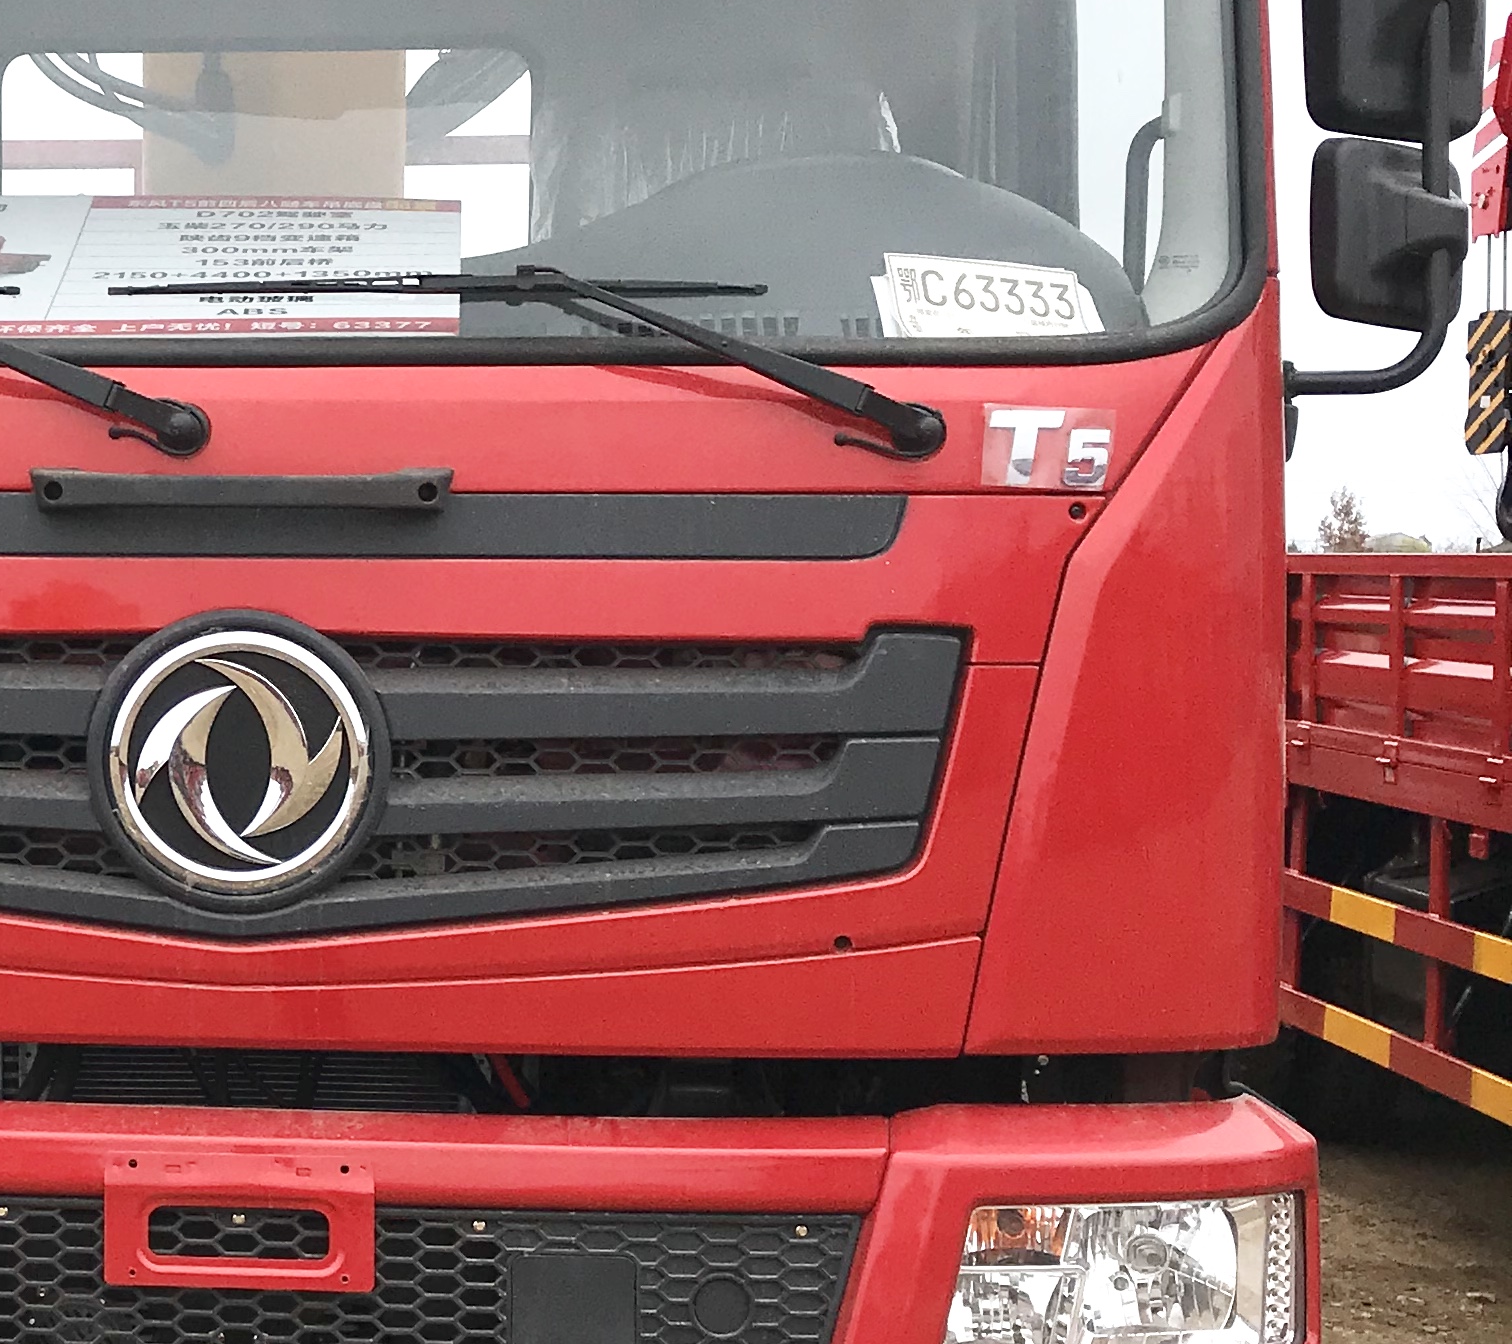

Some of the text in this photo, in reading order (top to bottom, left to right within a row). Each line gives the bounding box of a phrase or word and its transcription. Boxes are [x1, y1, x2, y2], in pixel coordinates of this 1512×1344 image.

[216, 307, 289, 316] ABS
[333, 320, 433, 330] 63377
[989, 409, 1111, 488] T5
